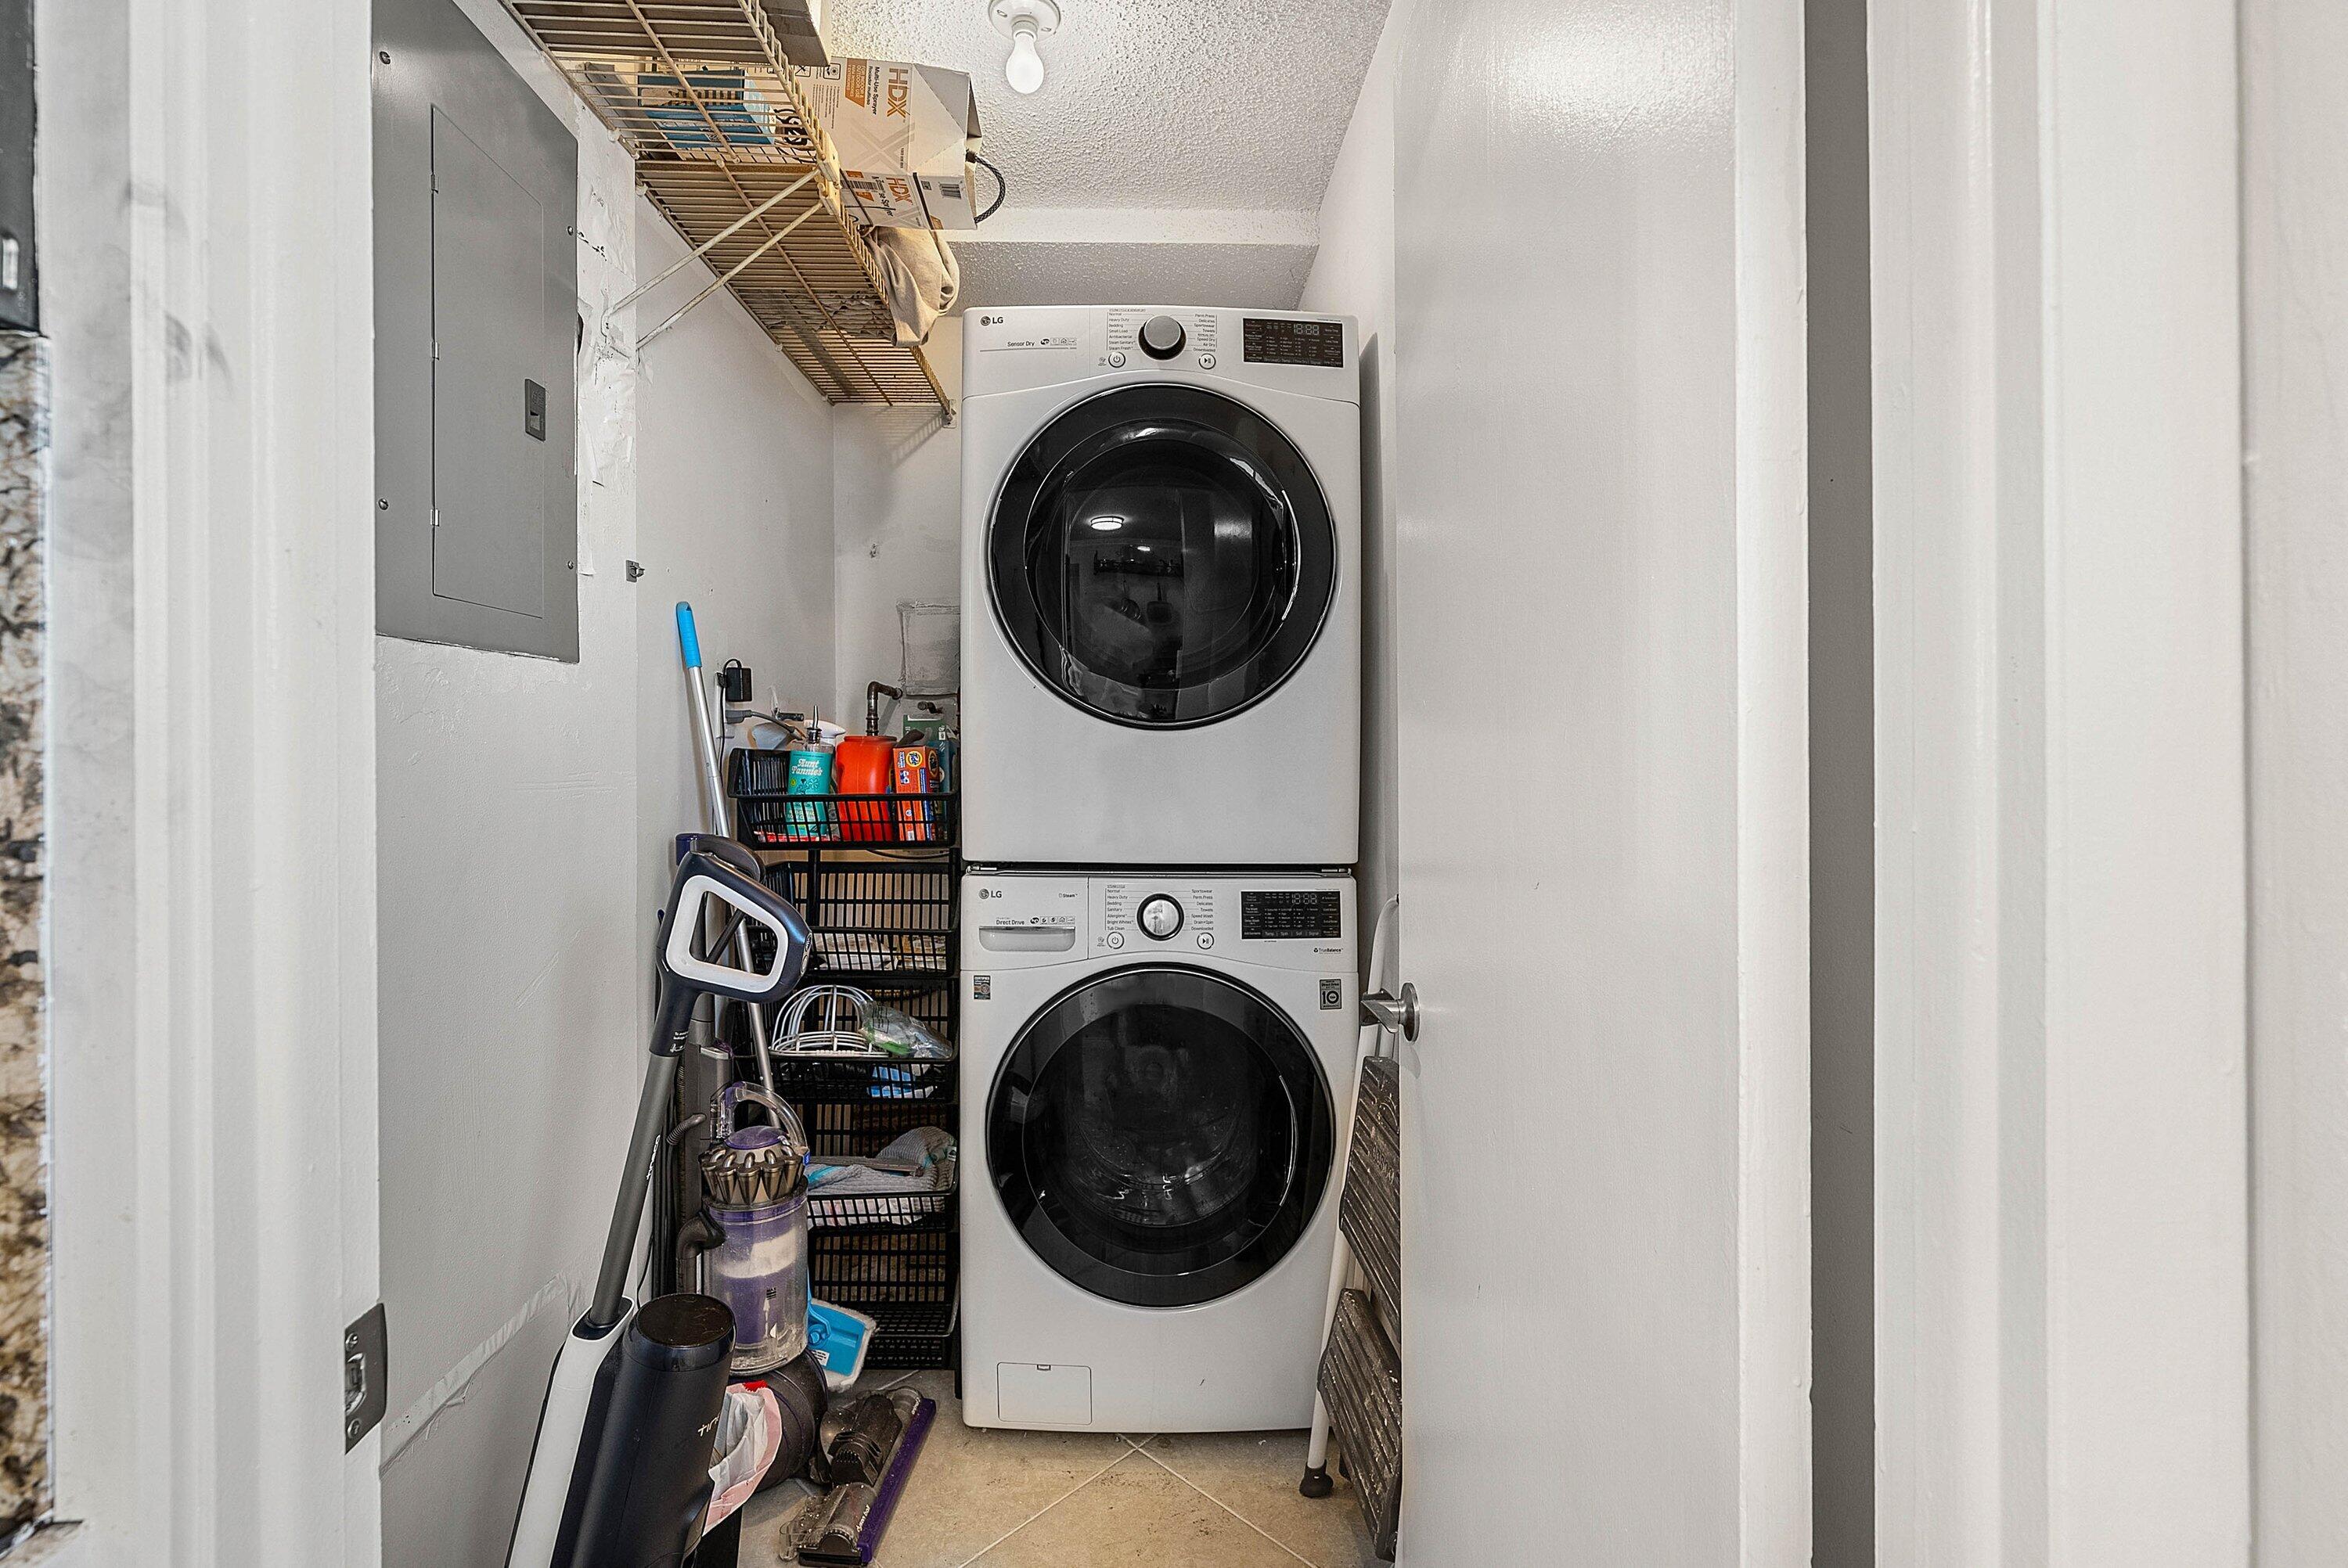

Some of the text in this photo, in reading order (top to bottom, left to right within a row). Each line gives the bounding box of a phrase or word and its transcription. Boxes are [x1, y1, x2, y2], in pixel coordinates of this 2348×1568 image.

[887, 68, 909, 118] HDX
[886, 177, 913, 203] HDX
[797, 758, 819, 768] Aunt
[909, 752, 918, 765] Tide
[1322, 991, 1339, 1004] 10
[856, 1516, 866, 1532] dyson
